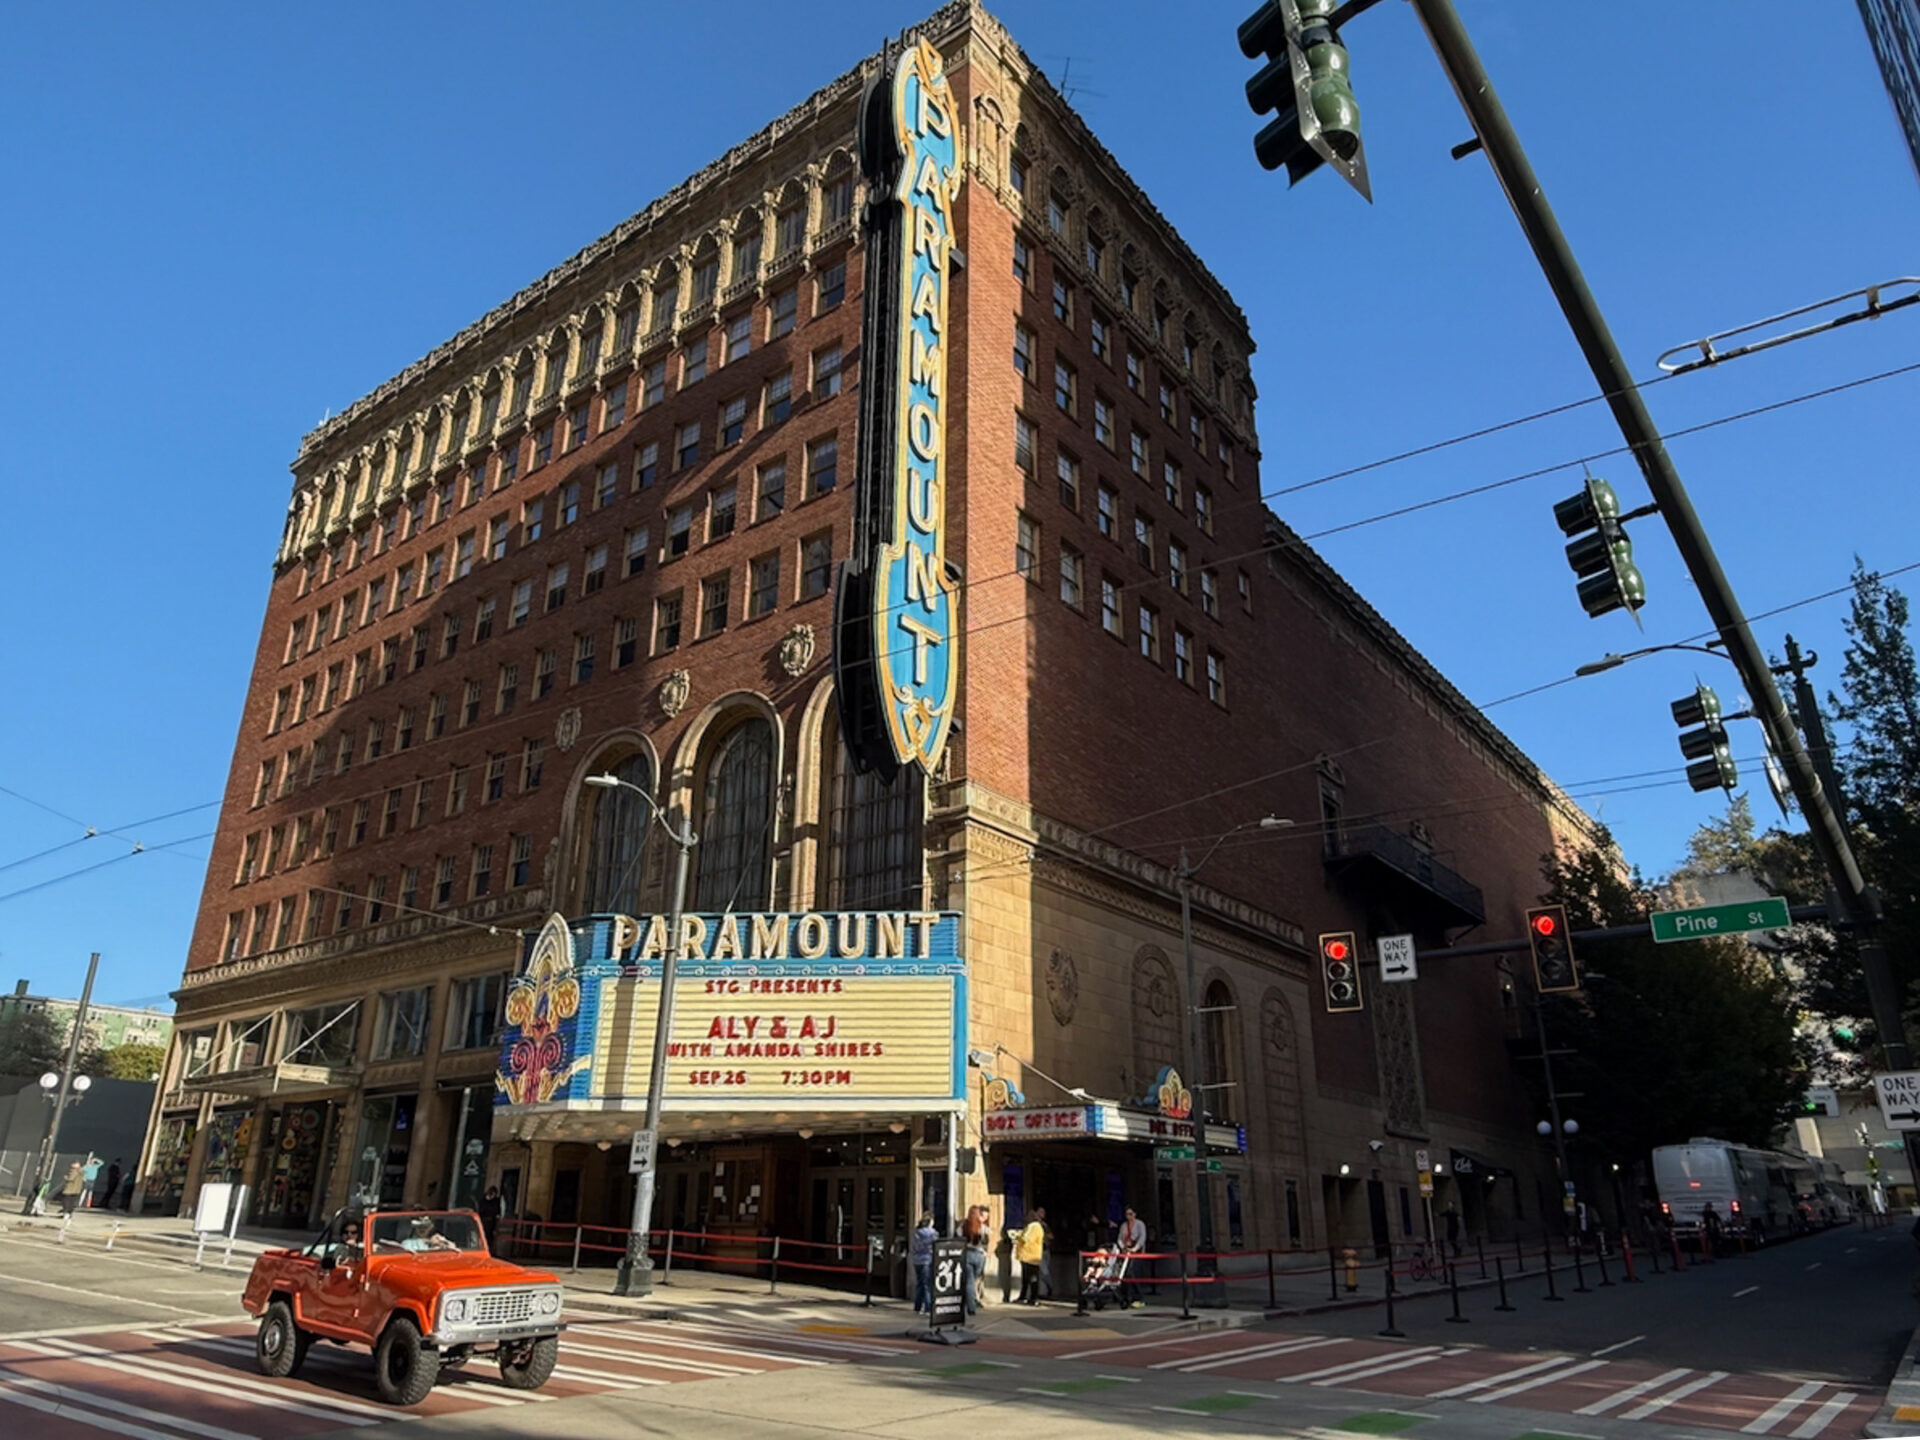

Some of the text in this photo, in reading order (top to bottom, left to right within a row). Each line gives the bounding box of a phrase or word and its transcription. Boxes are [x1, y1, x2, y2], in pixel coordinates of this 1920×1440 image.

[898, 84, 950, 686] PARAMOUNT
[1675, 912, 1764, 932] Pine St
[610, 913, 940, 960] PARAMOUNT
[1384, 939, 1407, 951] ONE
[1384, 950, 1408, 962] WAY
[705, 979, 843, 994] STG PRESENTS
[707, 1015, 836, 1039] ALY & AJ
[666, 1042, 884, 1057] WITH AMANDA SHIRES
[781, 1070, 851, 1085] 7:30PM
[1883, 1076, 1917, 1092] ONE
[1884, 1091, 1920, 1107] WAY
[986, 1110, 1079, 1131] BOX OFFICE
[637, 1133, 651, 1143] ONE
